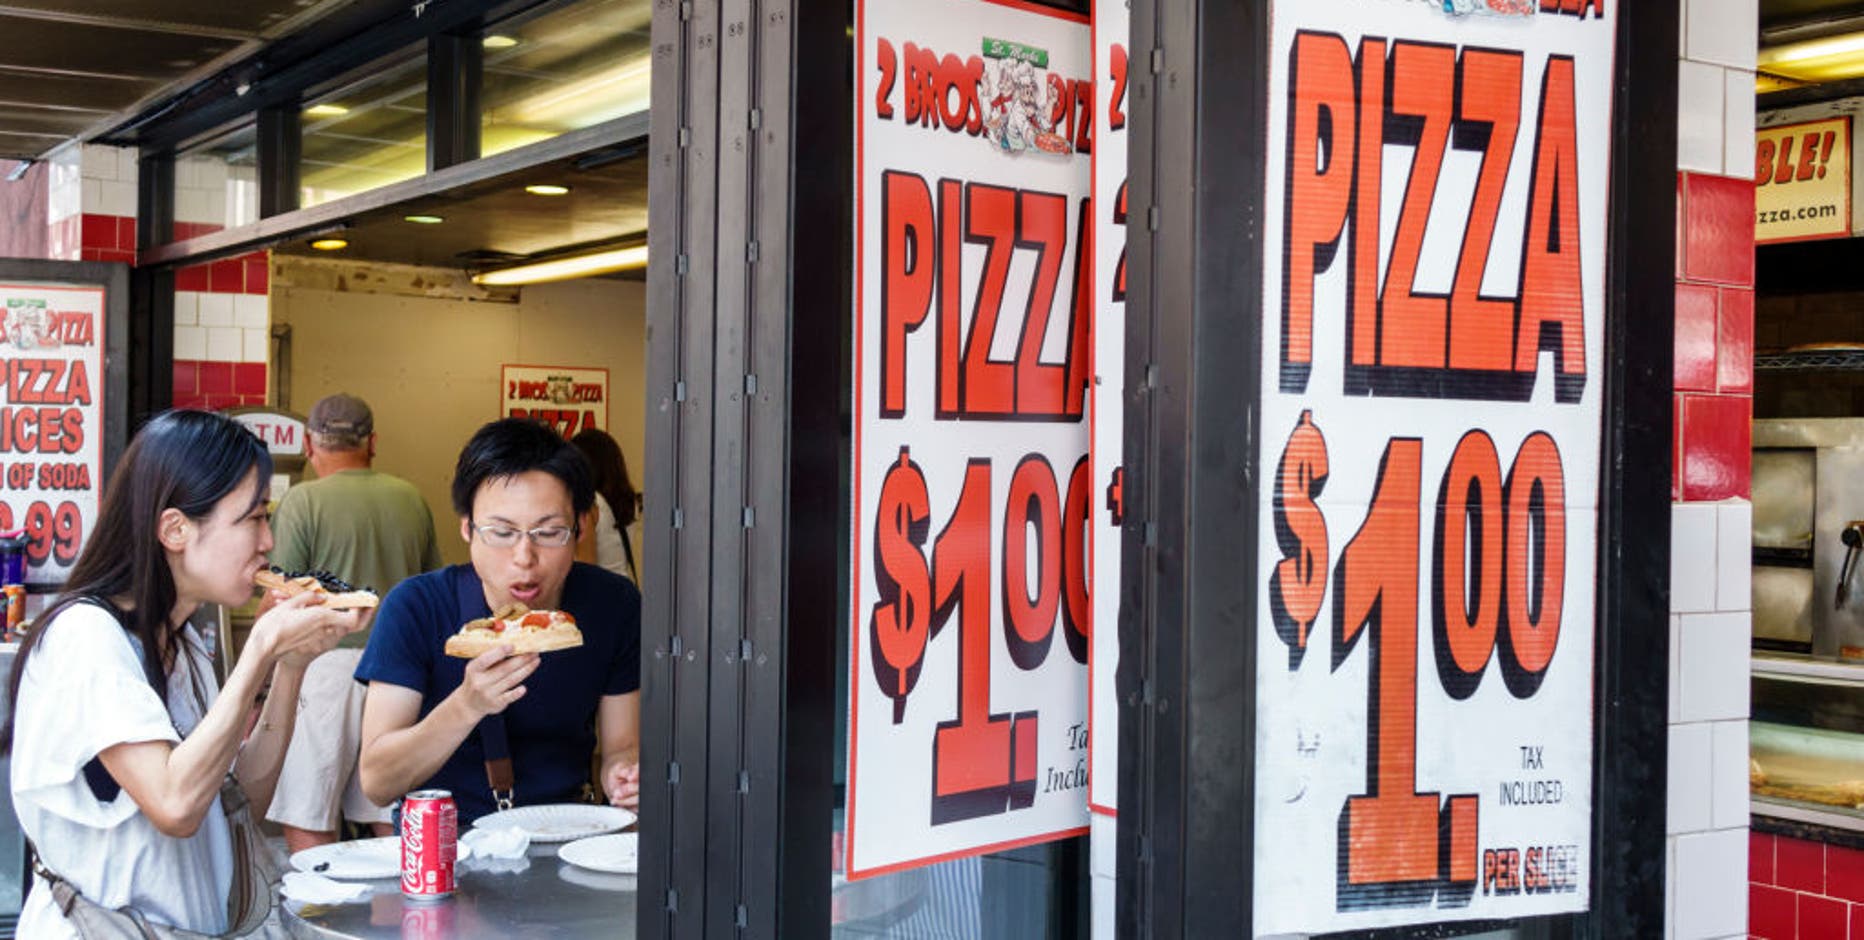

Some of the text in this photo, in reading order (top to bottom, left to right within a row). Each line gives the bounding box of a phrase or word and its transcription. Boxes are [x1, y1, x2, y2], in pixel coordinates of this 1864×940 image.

[876, 37, 897, 120] 2
[903, 41, 984, 137] BROS
[1755, 131, 1836, 186] BLE!
[1279, 28, 1587, 404] PIZZA
[1755, 204, 1837, 224] zza.com
[0, 406, 84, 454] ICES
[7, 462, 35, 490] OF
[38, 462, 91, 491] SODA
[1269, 409, 1566, 913] $1.00
[1520, 746, 1544, 770] TAX
[1500, 780, 1562, 806] INCLUDED
[1483, 845, 1578, 896] PER SLICE
